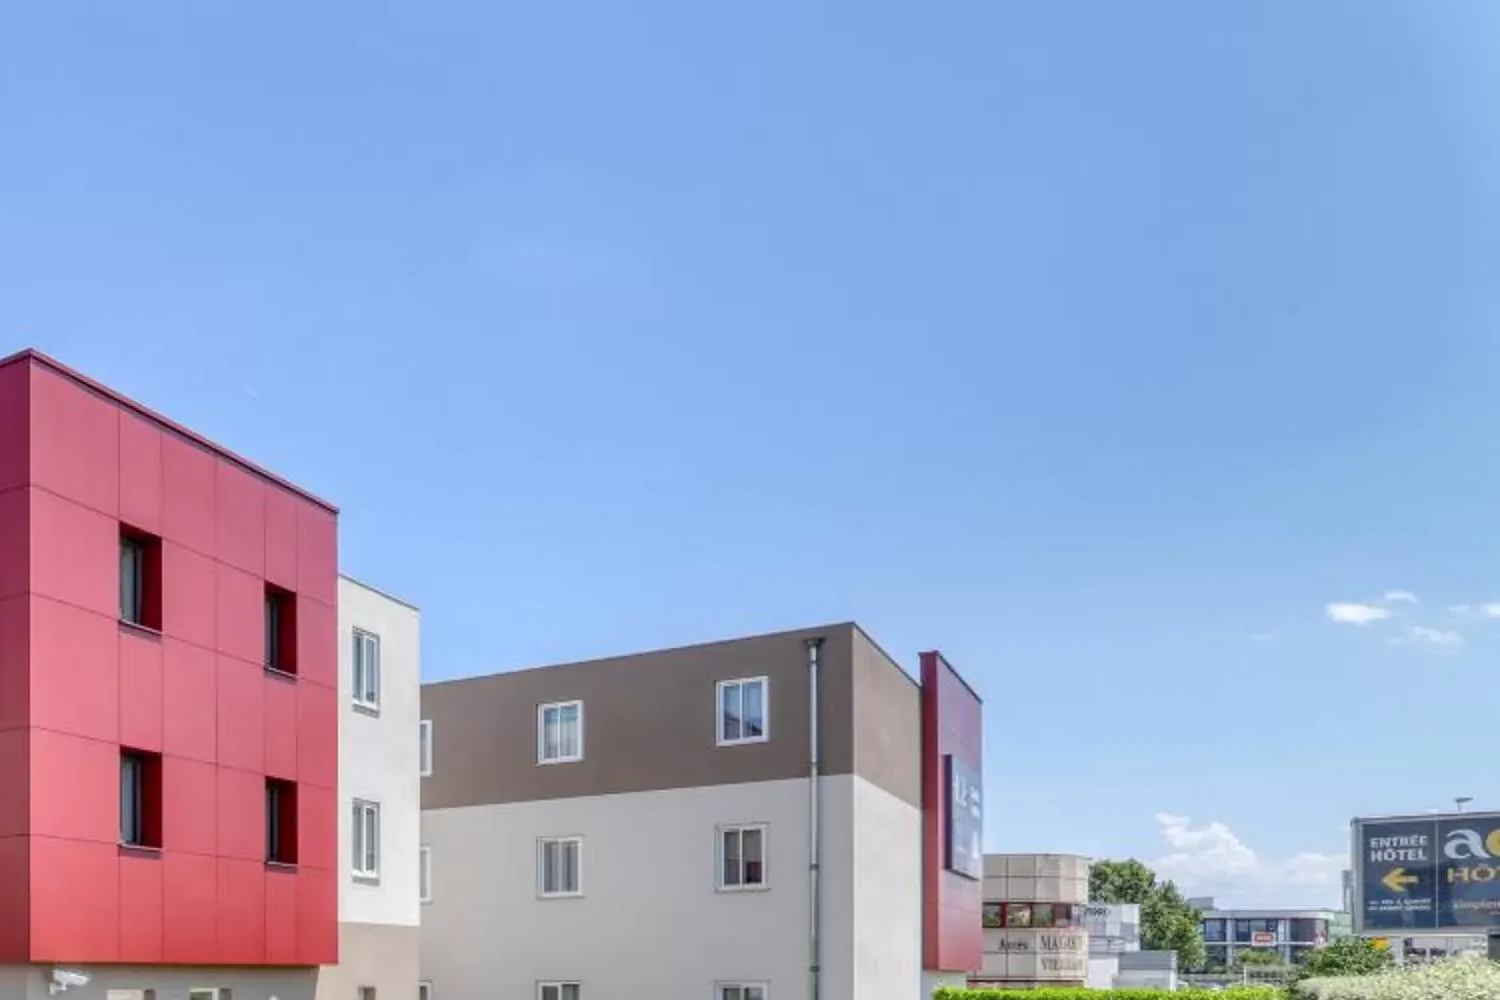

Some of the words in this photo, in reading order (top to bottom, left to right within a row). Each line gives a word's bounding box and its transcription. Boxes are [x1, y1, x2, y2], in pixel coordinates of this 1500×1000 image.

[1369, 834, 1428, 849] ENTRÉE
[1370, 847, 1428, 862] HÔTEL
[1446, 863, 1500, 882] HÔ
